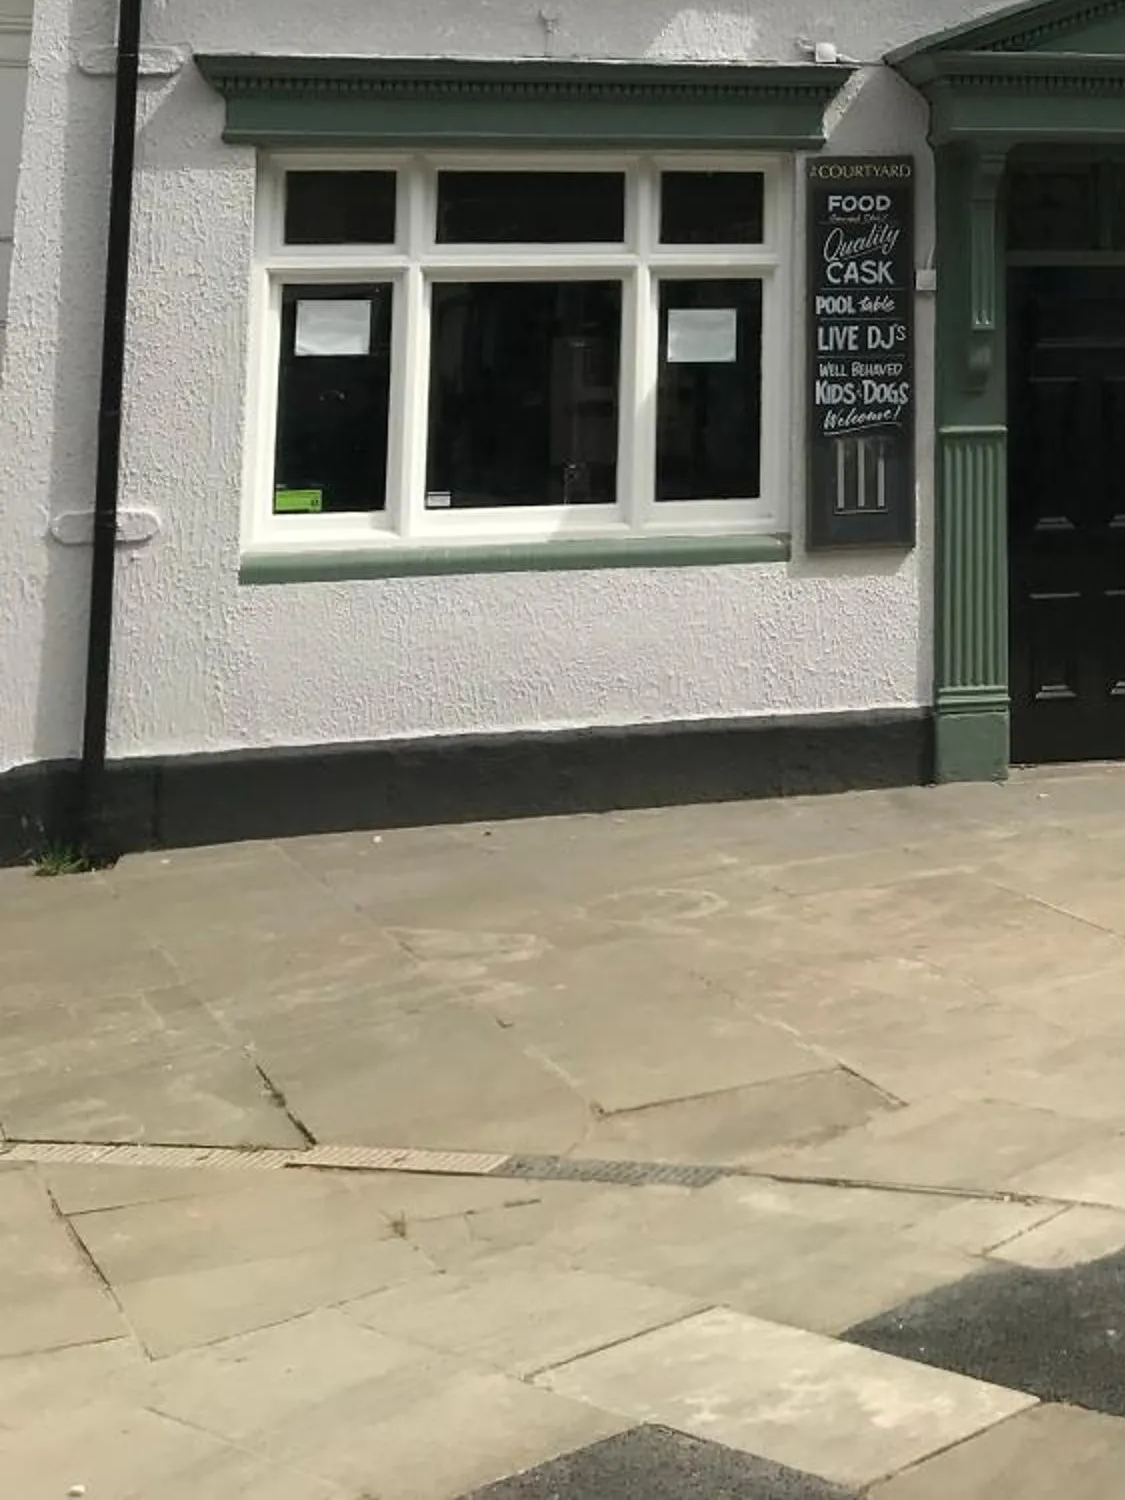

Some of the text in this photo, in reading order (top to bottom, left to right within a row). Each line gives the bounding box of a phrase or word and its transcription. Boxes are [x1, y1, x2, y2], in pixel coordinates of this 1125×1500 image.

[818, 164, 911, 179] COURTYARD
[828, 195, 891, 212] FOOD
[823, 223, 900, 262] Quality
[826, 260, 894, 285] CASK
[815, 295, 895, 315] POOL table
[817, 325, 859, 351] LIVE
[819, 361, 903, 377] WELL BEHAVED
